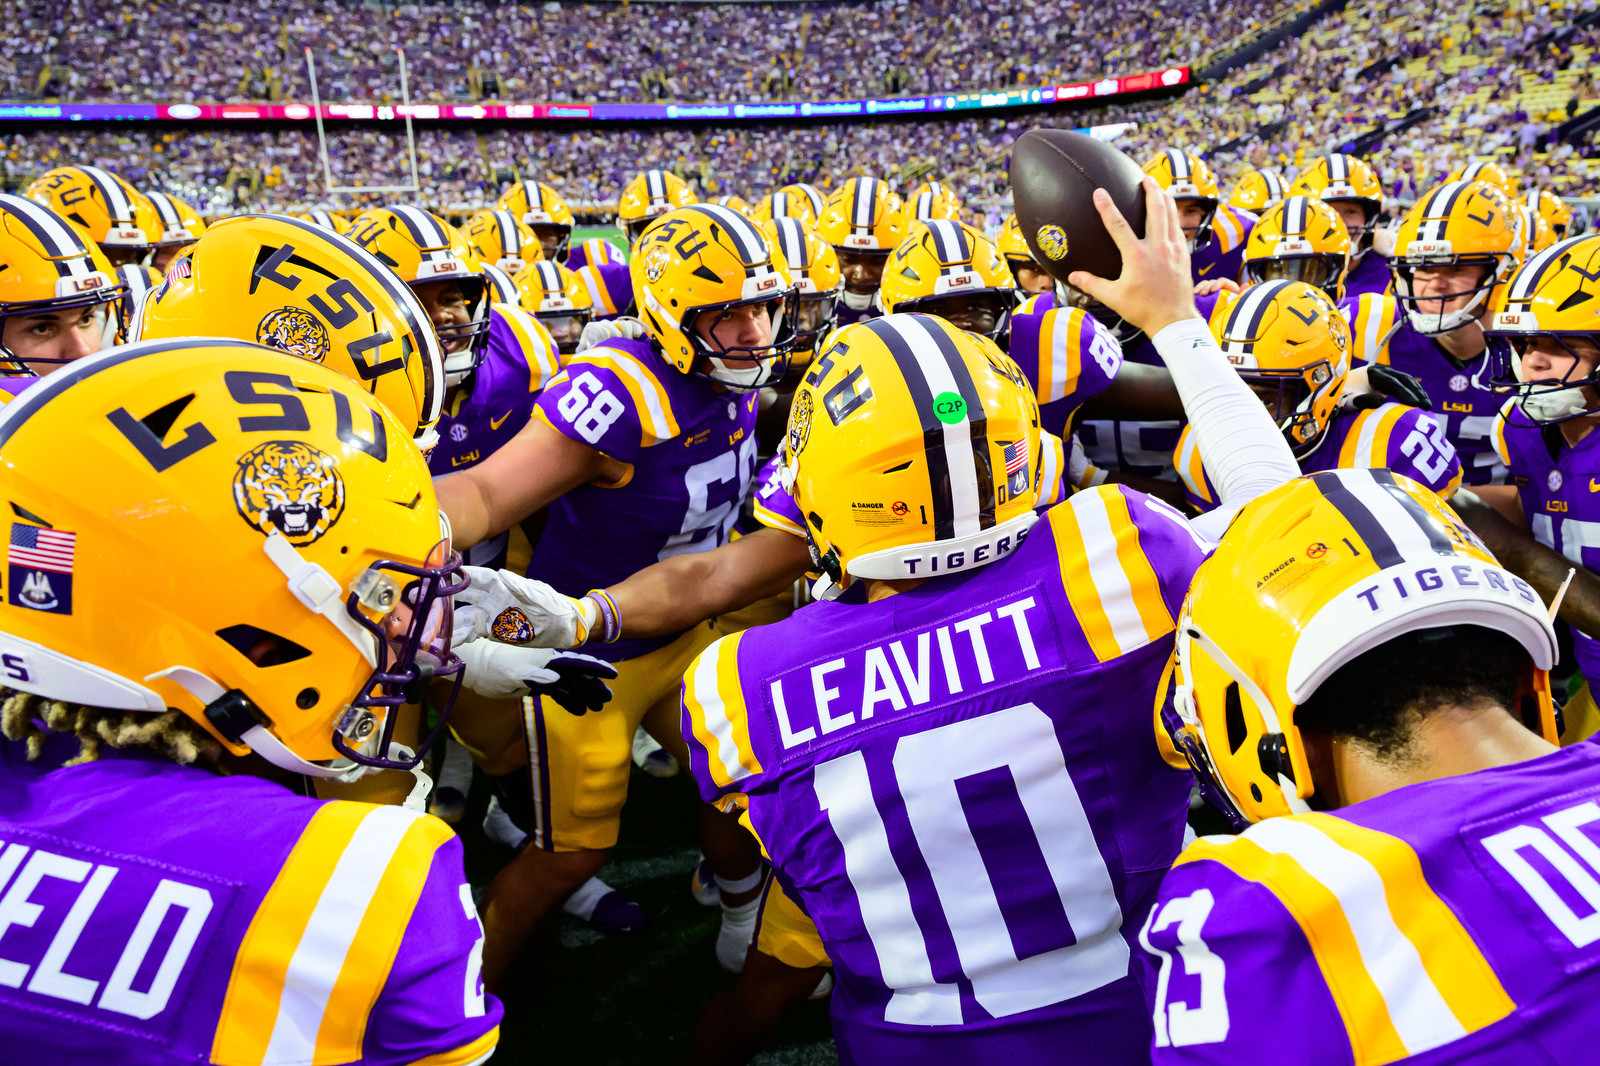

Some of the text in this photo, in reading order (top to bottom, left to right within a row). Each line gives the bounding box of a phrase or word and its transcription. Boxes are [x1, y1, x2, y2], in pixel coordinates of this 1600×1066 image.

[432, 262, 457, 273] LSU
[73, 276, 103, 292] LSU
[756, 278, 777, 291] LSU
[948, 275, 972, 287] LSU
[254, 243, 405, 381] LSU
[1500, 315, 1521, 325] LSU
[557, 371, 625, 444] 68
[936, 400, 963, 415] C2P
[1442, 401, 1473, 413] LSU
[107, 371, 387, 472] LSU
[451, 449, 480, 467] LSU
[1400, 414, 1455, 485] 22
[1546, 500, 1568, 512] LSU
[904, 528, 1028, 574] TIGERS
[1263, 557, 1296, 582] DANGER
[1356, 565, 1536, 612] TIGERS
[770, 596, 1041, 750] LEAVITT
[813, 702, 1131, 1026] 10
